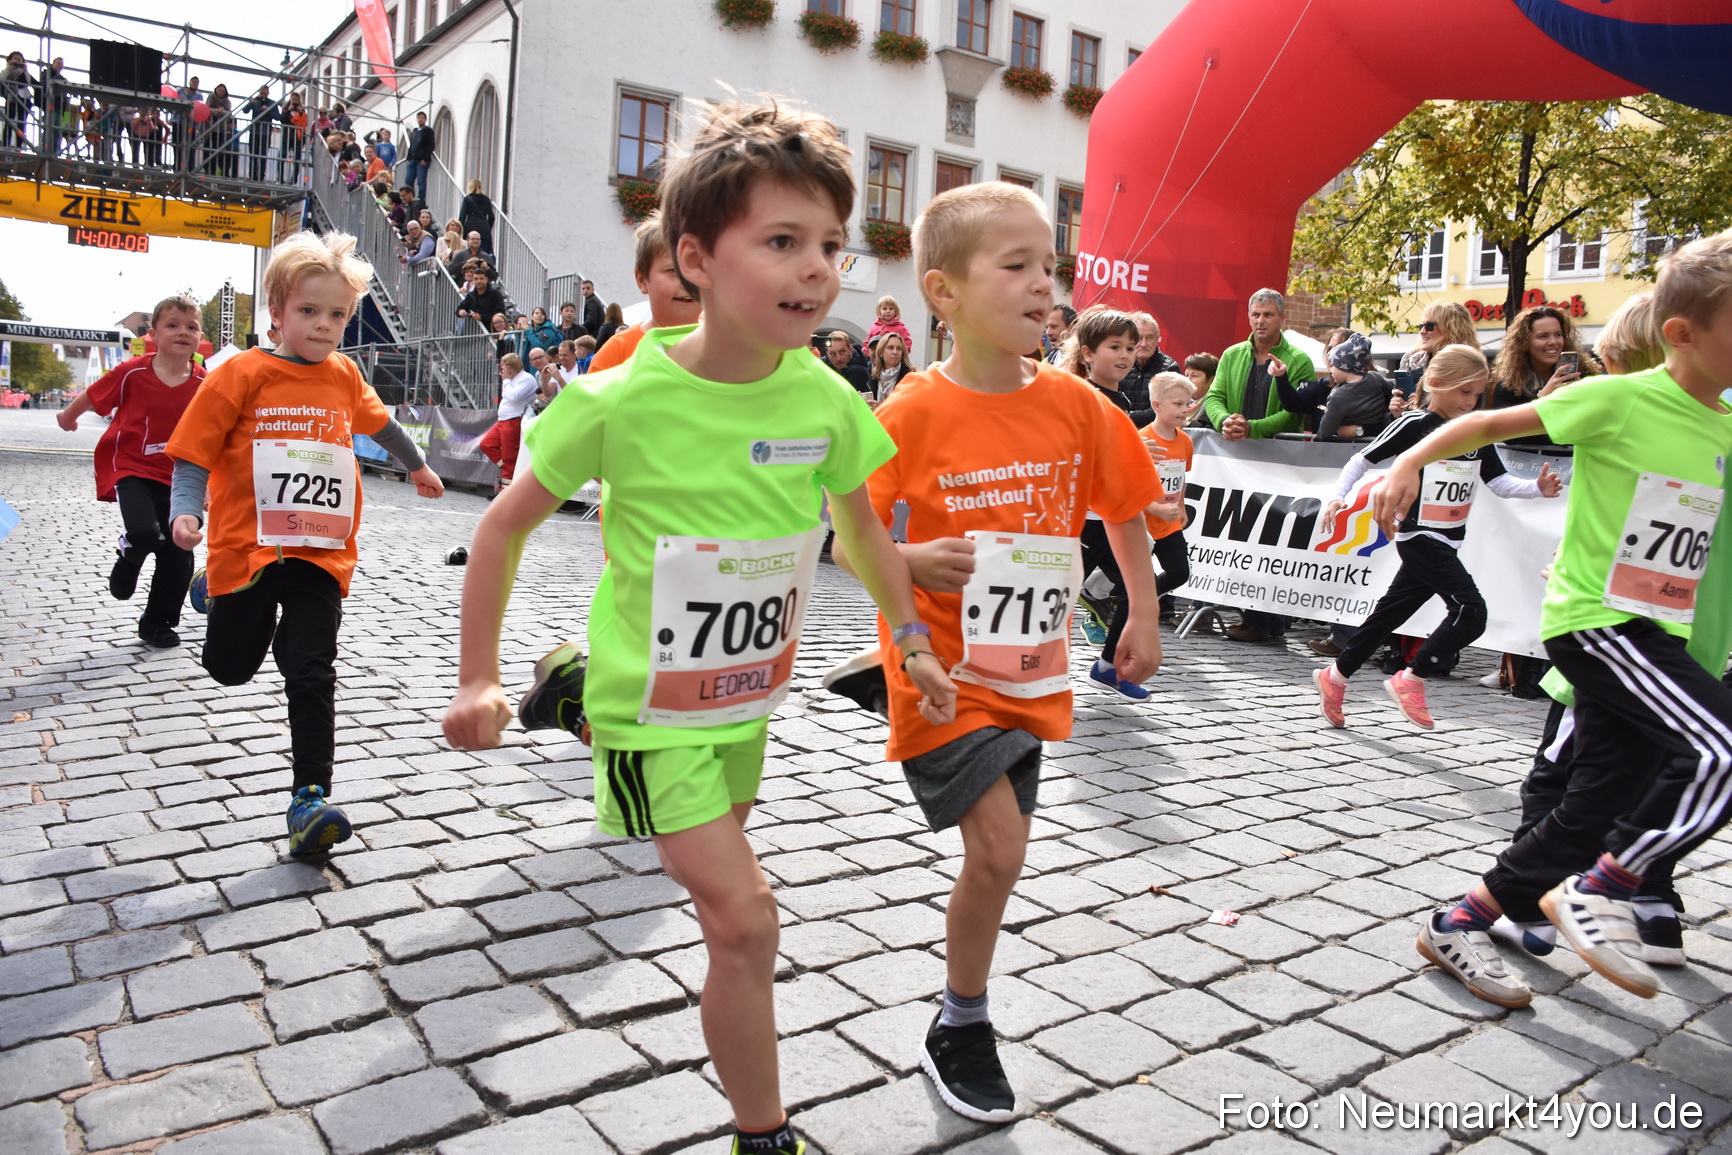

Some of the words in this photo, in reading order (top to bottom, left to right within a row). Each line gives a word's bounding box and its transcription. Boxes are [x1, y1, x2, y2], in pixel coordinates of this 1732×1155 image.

[1077, 251, 1150, 293] STORE
[6, 324, 36, 336] MINI
[255, 405, 327, 418] Neumarkter
[255, 420, 314, 432] Stadtlauf
[299, 450, 333, 463] BOCK
[938, 461, 1052, 490] Neumarkter
[1530, 463, 1563, 475] Frezeit
[271, 473, 342, 509] 7225
[945, 484, 1034, 513] Stadtlauf
[1435, 481, 1474, 502] 7064
[287, 514, 329, 534] Simon
[740, 552, 796, 575] BOCK
[1027, 551, 1072, 566] BOCK
[1186, 543, 1253, 571] twerke
[1257, 556, 1372, 586] neumarkt
[1188, 574, 1214, 591] wir
[1215, 577, 1266, 600] bieten
[1272, 585, 1375, 616] lebensqual
[1658, 582, 1690, 600] Aaron
[989, 586, 1070, 634] 7136
[686, 587, 798, 659] 7080
[659, 651, 673, 663] B4
